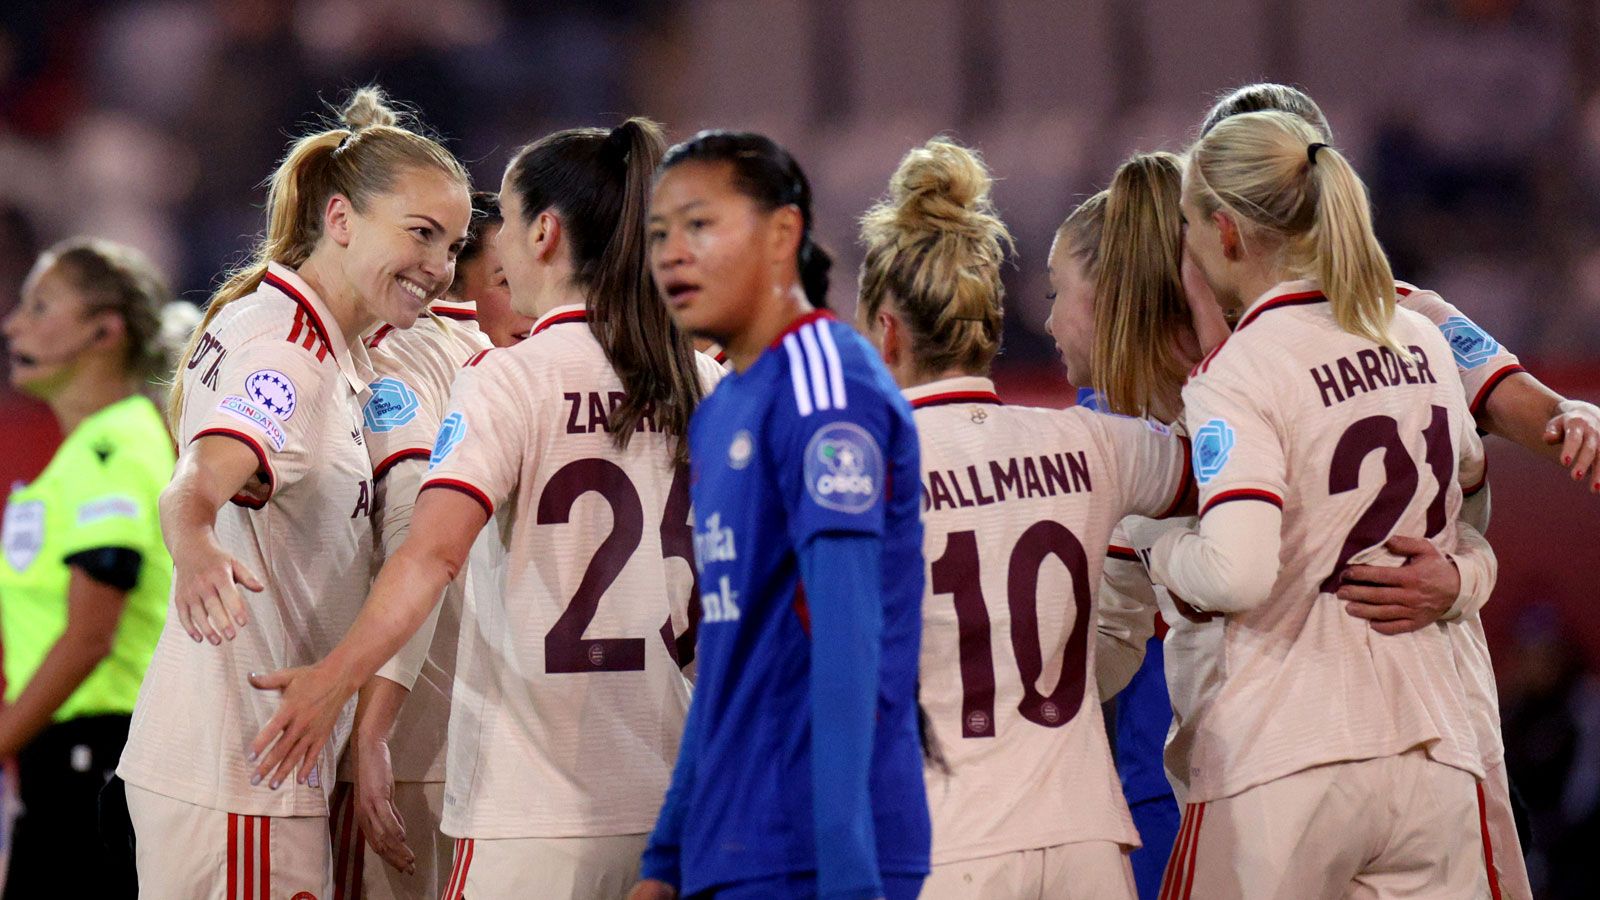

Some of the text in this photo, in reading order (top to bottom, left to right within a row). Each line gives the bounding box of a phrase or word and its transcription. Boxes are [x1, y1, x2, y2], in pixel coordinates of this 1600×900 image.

[1309, 345, 1438, 408] HARDER
[221, 399, 286, 446] FOUNDATION
[920, 450, 1093, 512] ALLMANN
[1319, 404, 1454, 593] 21
[931, 519, 1092, 739] 10
